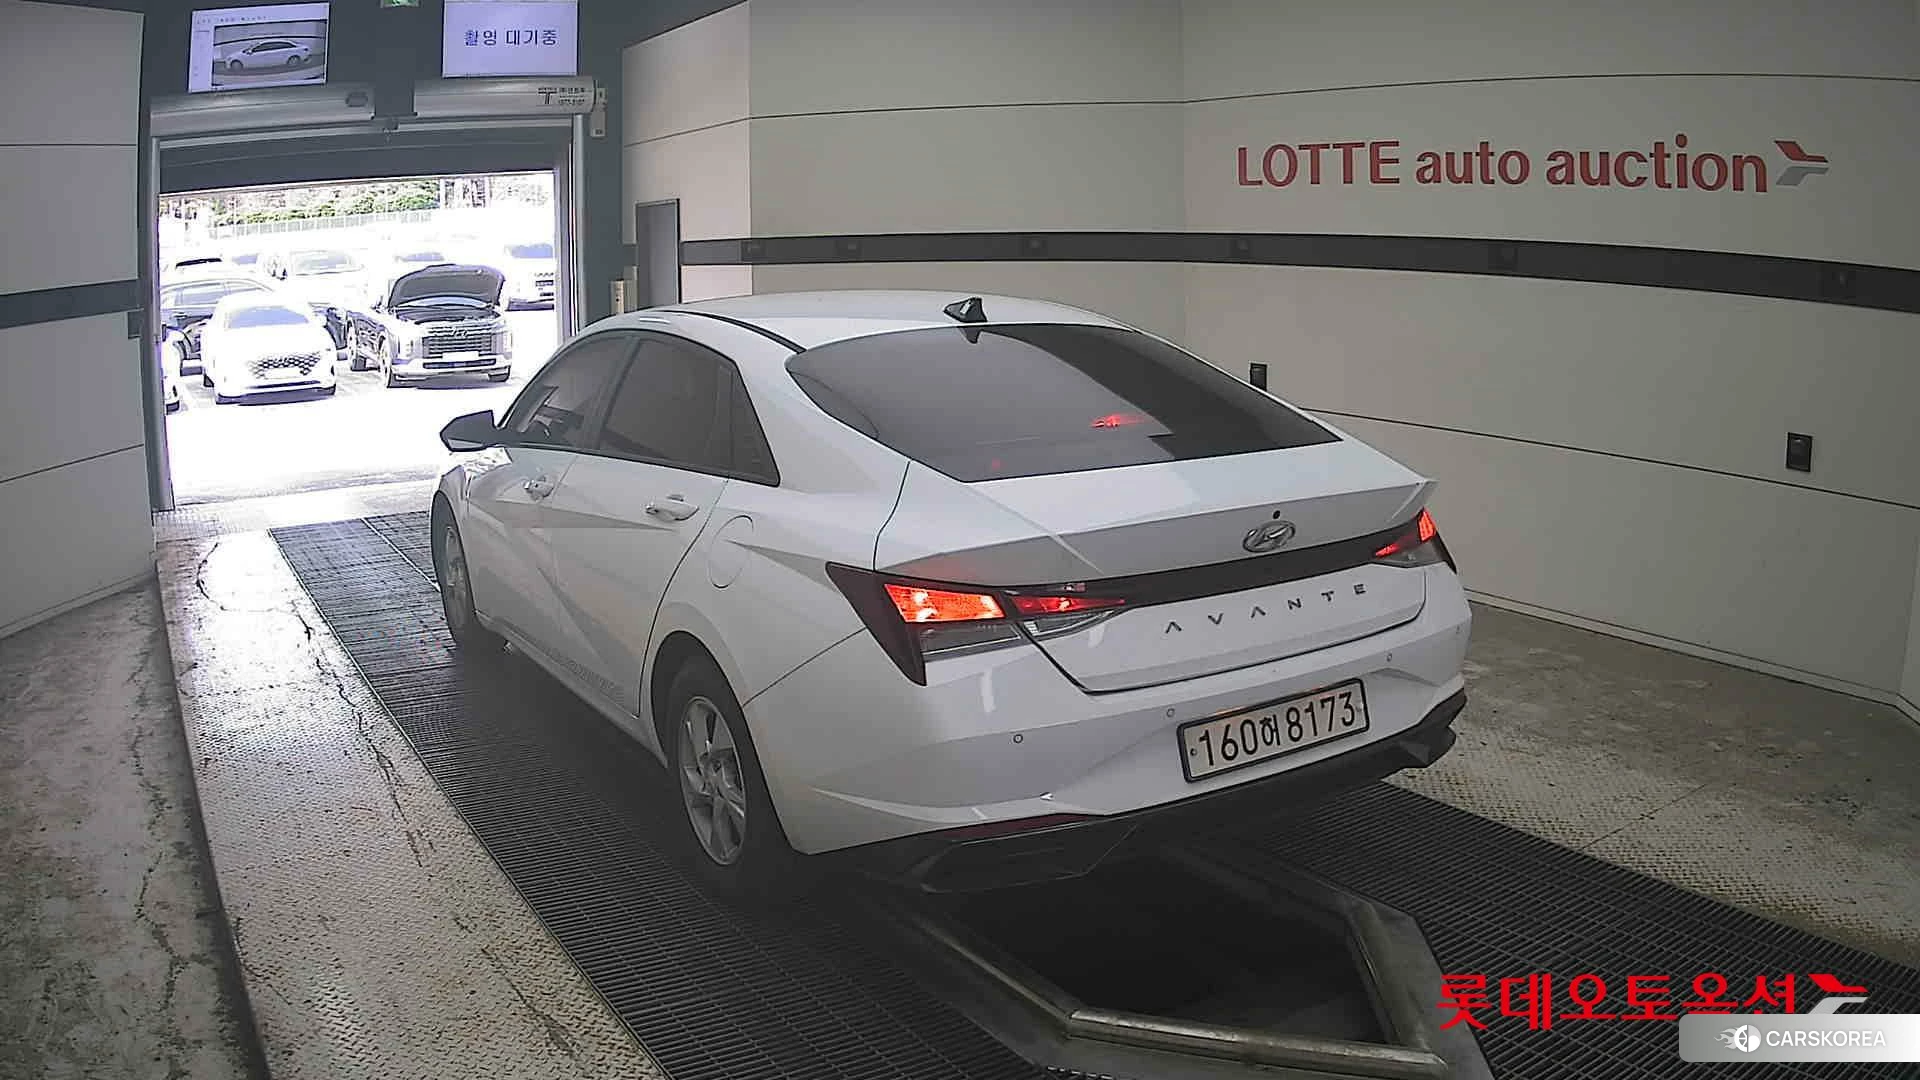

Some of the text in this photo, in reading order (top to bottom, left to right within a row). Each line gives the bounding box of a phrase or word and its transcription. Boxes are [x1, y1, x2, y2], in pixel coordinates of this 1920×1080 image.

[505, 29, 559, 47] 대기중
[1237, 134, 1767, 193] LOTTE auto auction
[1164, 583, 1367, 634] AVANTE
[1198, 691, 1356, 767] 160허8173
